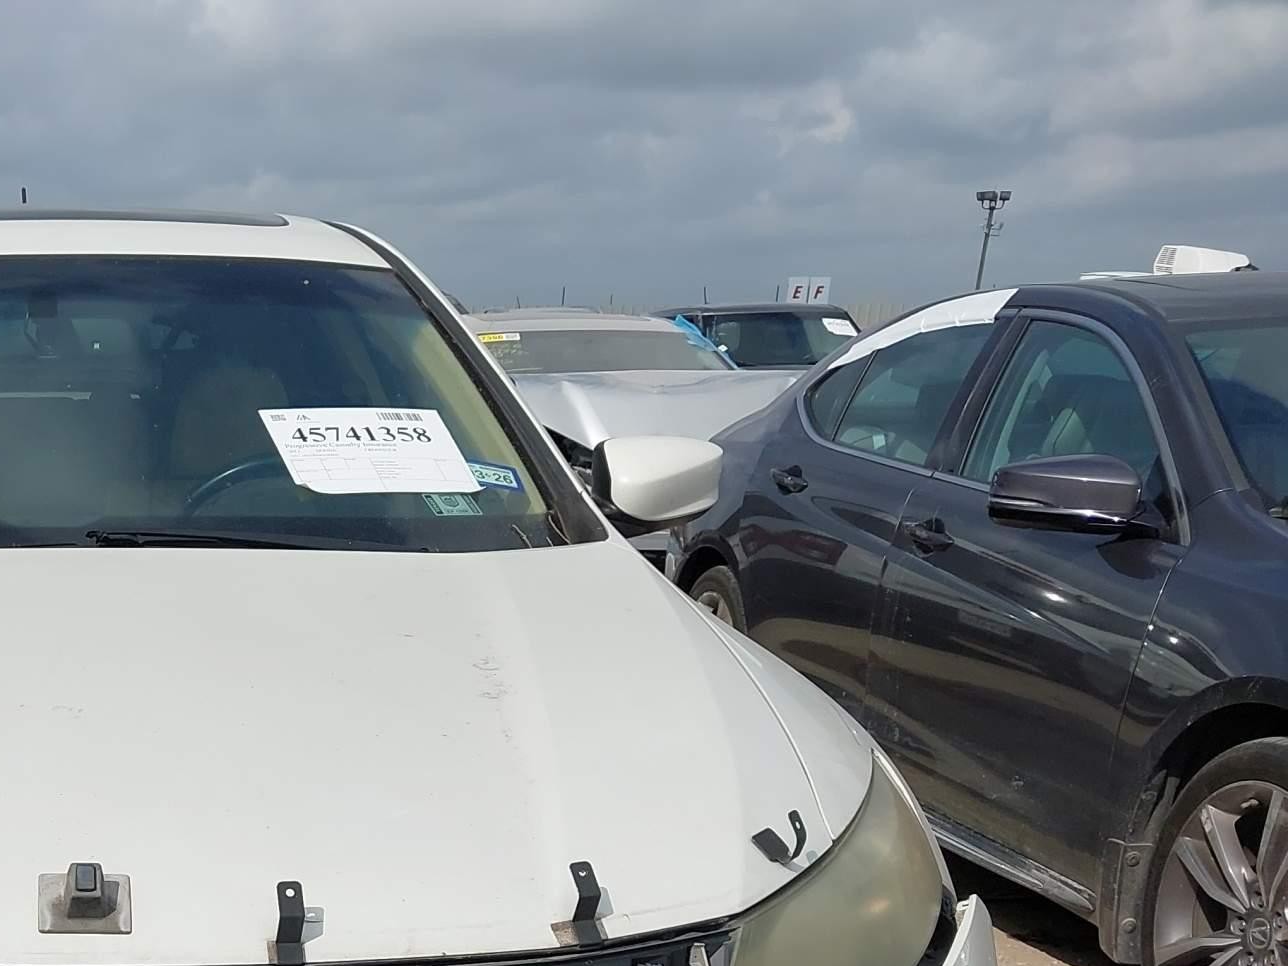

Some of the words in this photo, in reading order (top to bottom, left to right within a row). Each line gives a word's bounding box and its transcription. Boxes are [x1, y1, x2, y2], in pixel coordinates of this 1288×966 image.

[792, 285, 803, 299] E
[814, 285, 825, 299] F
[292, 426, 432, 443] 45741358
